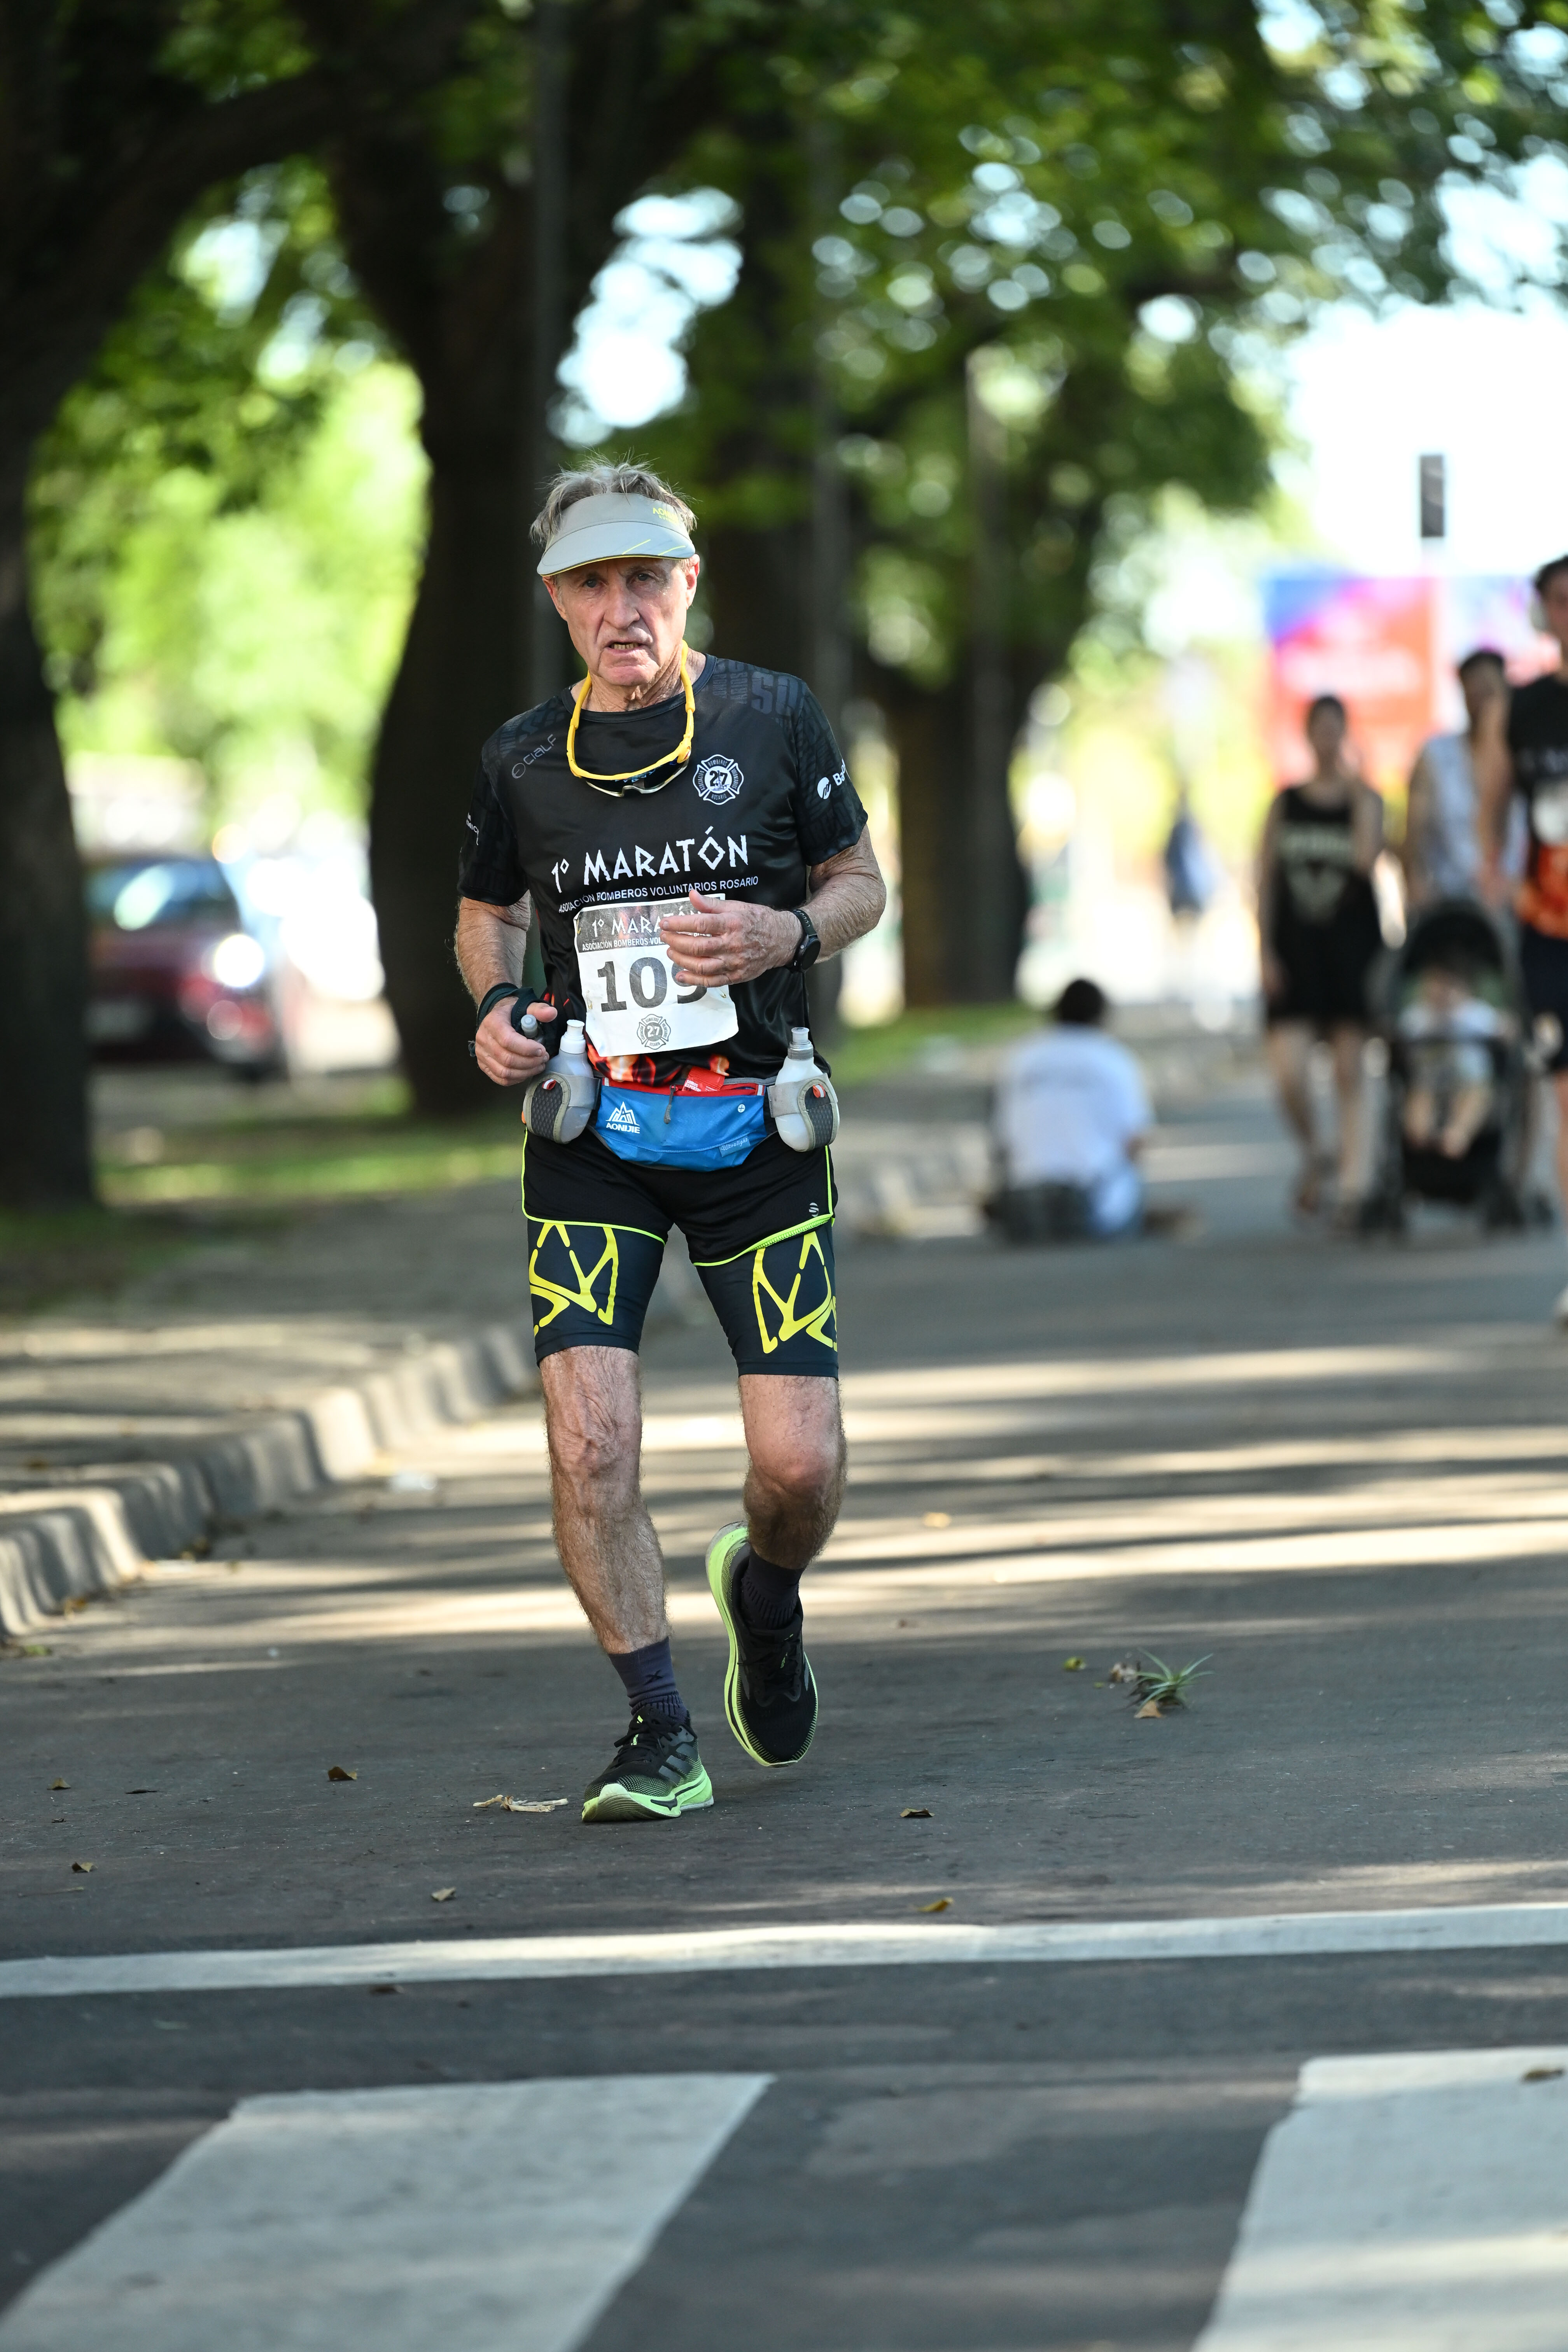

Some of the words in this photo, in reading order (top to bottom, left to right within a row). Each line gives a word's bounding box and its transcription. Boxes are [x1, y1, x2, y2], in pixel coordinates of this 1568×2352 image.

[709, 770, 728, 787] 27
[583, 826, 749, 886] MARATÓN
[596, 887, 648, 901] BOMBEROS
[649, 881, 717, 896] VOLUNTARIOS
[720, 876, 758, 890] ROSARIO
[614, 938, 648, 948] BOMBEROS
[646, 1025, 660, 1038] 27
[606, 1122, 640, 1134] AONIJIE
